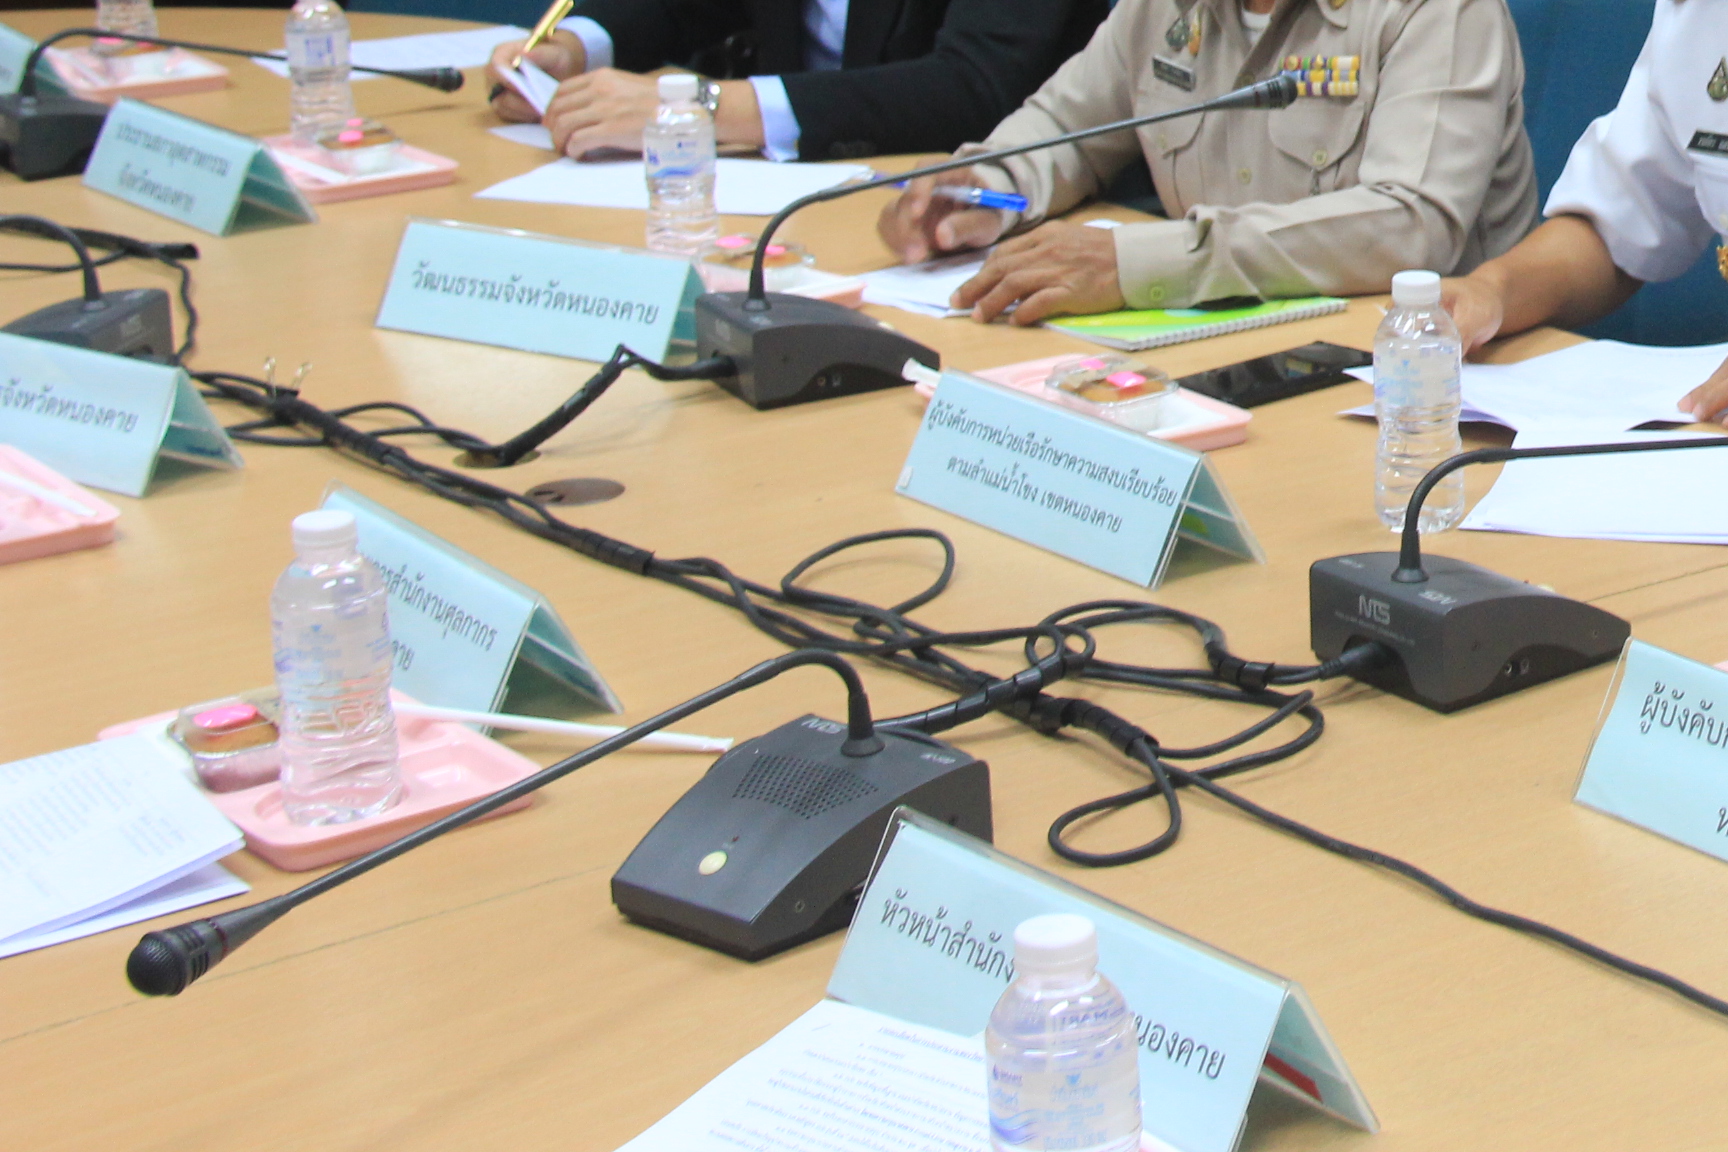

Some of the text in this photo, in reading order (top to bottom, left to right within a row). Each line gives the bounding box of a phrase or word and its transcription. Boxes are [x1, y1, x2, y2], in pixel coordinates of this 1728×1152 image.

[411, 260, 660, 325] วัฒนธรรมจังหวัดหนองคาย
[0, 377, 140, 433] จังหวัดหนองคาย
[927, 399, 1179, 508] ผู้บังคับการหน่วยเรือรักษาความสงบเรียบร้อย
[946, 454, 1123, 534] ตามลำแม่น้ำโขง เขตหนองคาย
